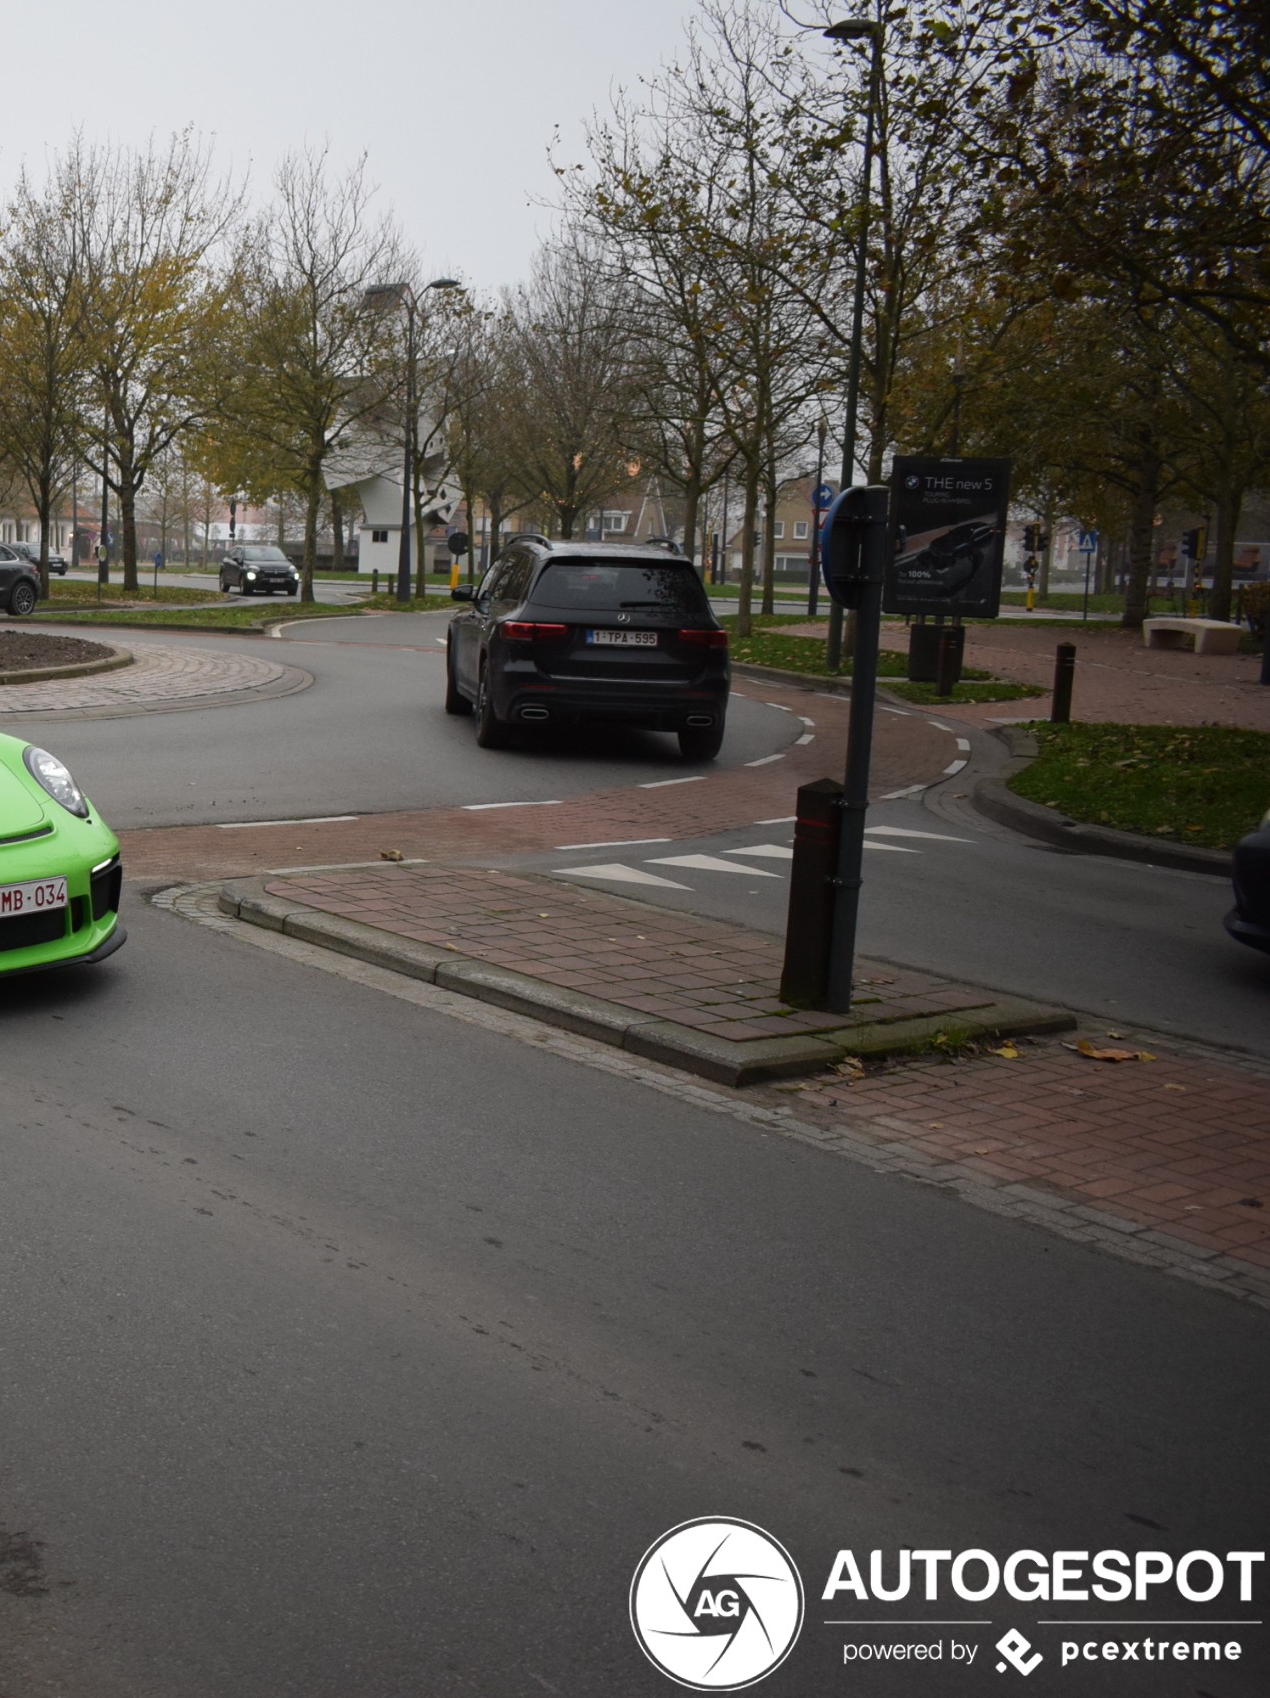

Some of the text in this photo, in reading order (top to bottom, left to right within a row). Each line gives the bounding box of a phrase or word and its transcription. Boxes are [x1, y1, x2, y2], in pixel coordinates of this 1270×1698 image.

[924, 476, 993, 490] THE new 5
[908, 570, 932, 578] 100%
[595, 632, 656, 644] 1-TPA-595
